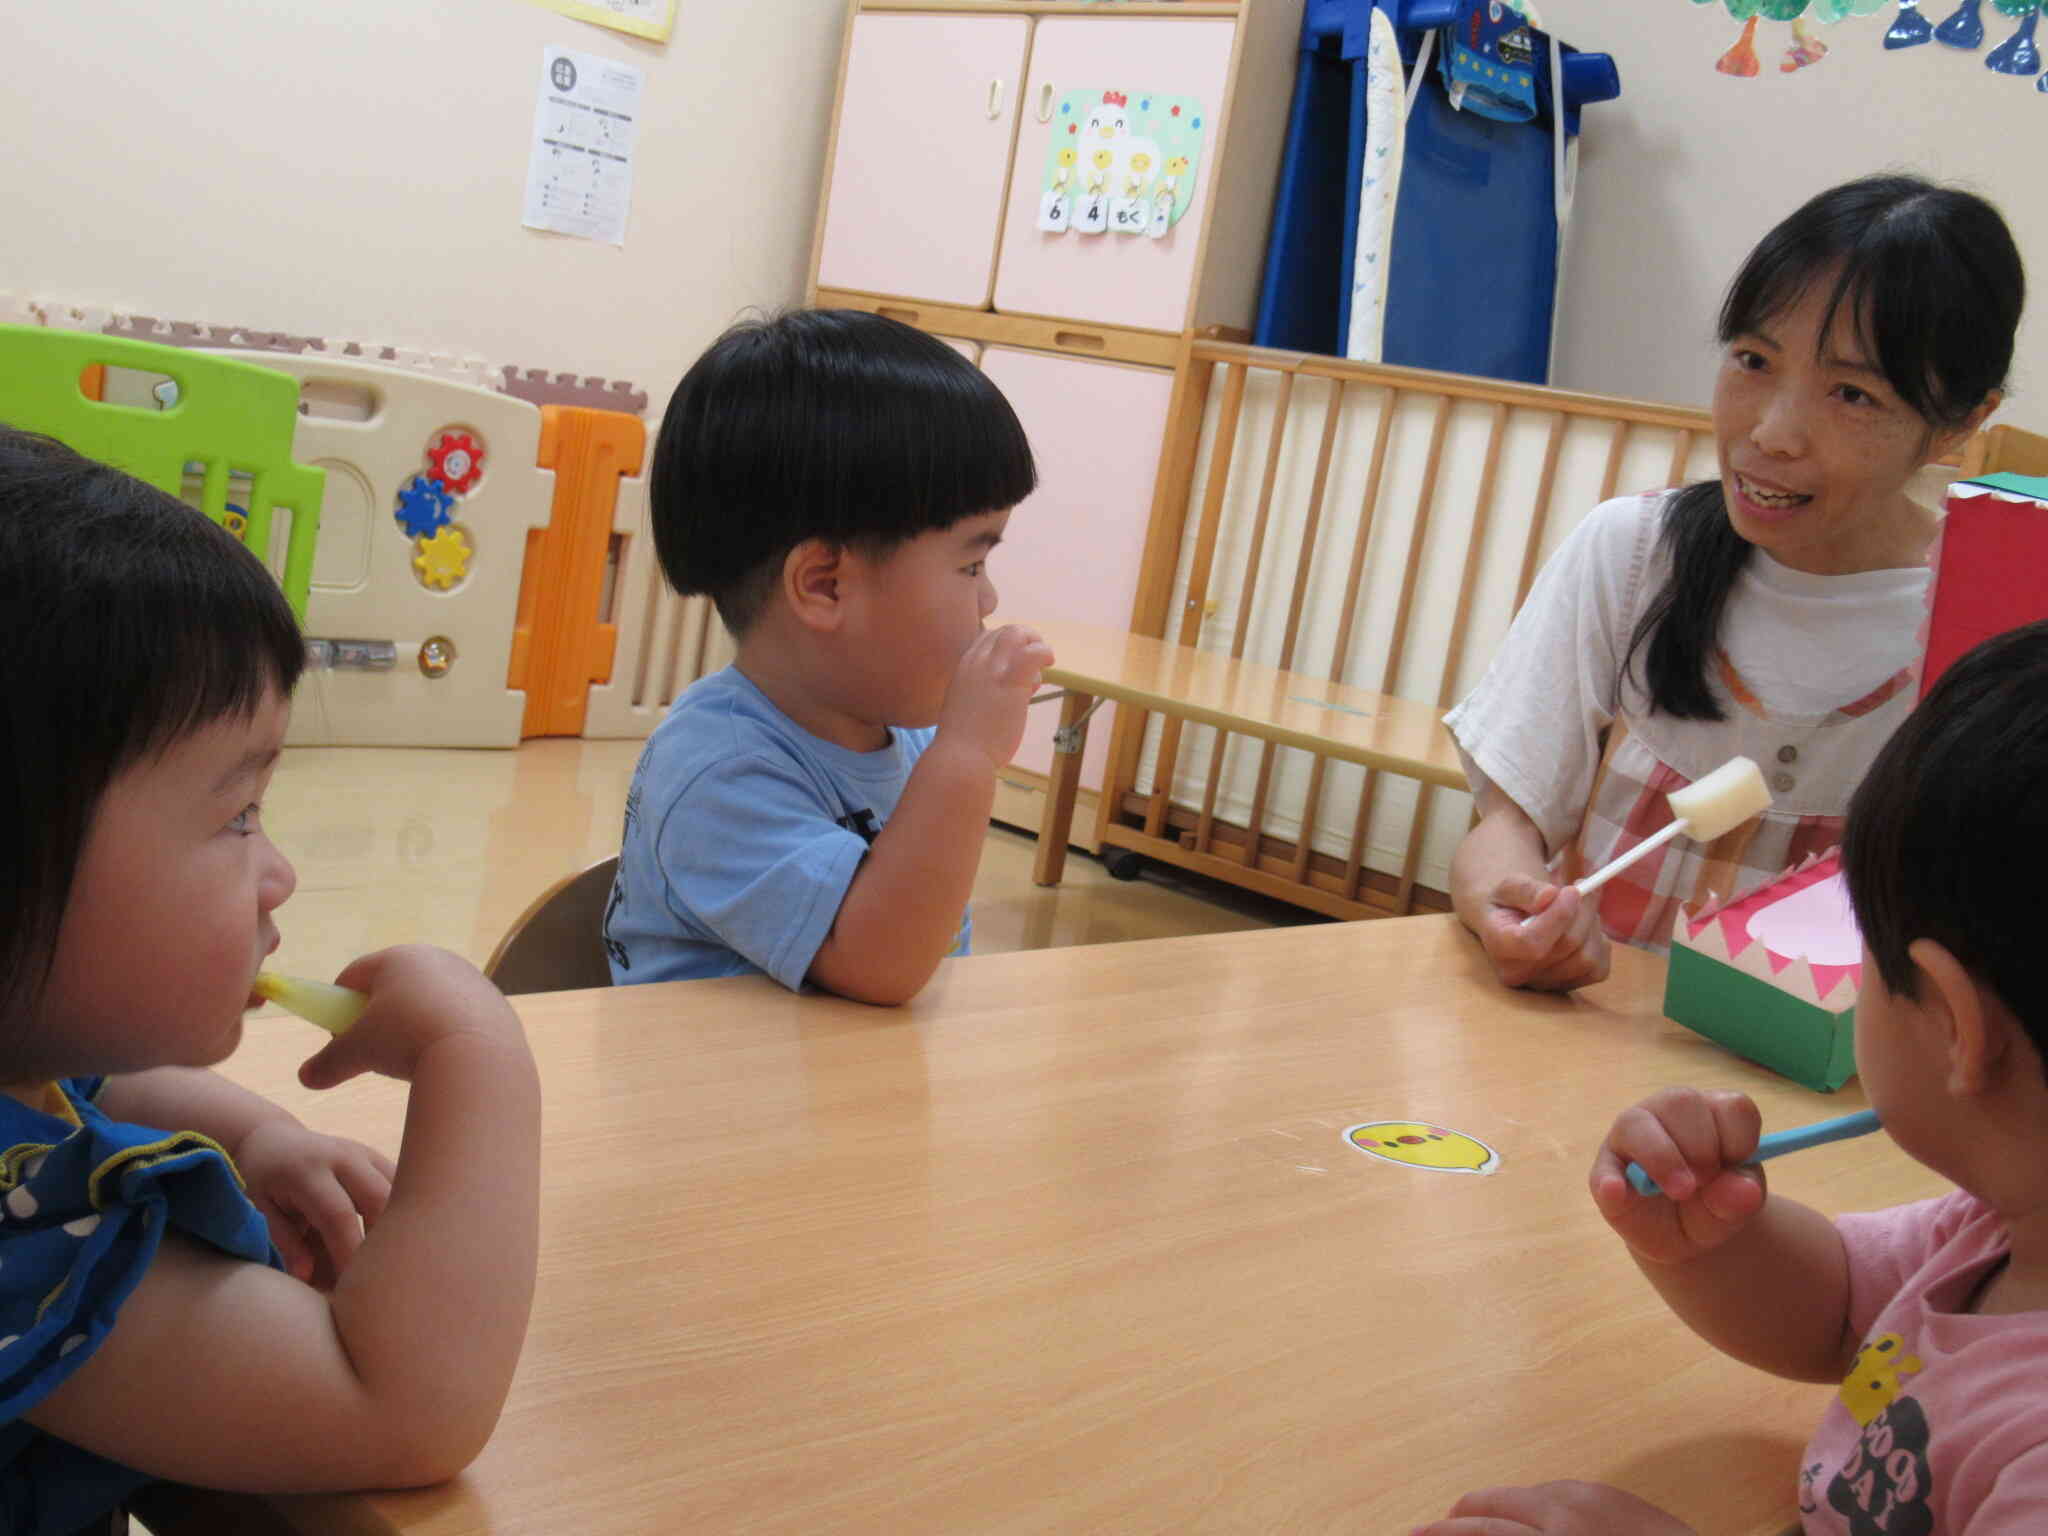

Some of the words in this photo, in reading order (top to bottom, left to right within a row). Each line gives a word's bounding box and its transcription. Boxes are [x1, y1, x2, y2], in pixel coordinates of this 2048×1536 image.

[1049, 205, 1062, 220] 6
[1087, 206, 1099, 221] 4
[1116, 210, 1140, 224] もく
